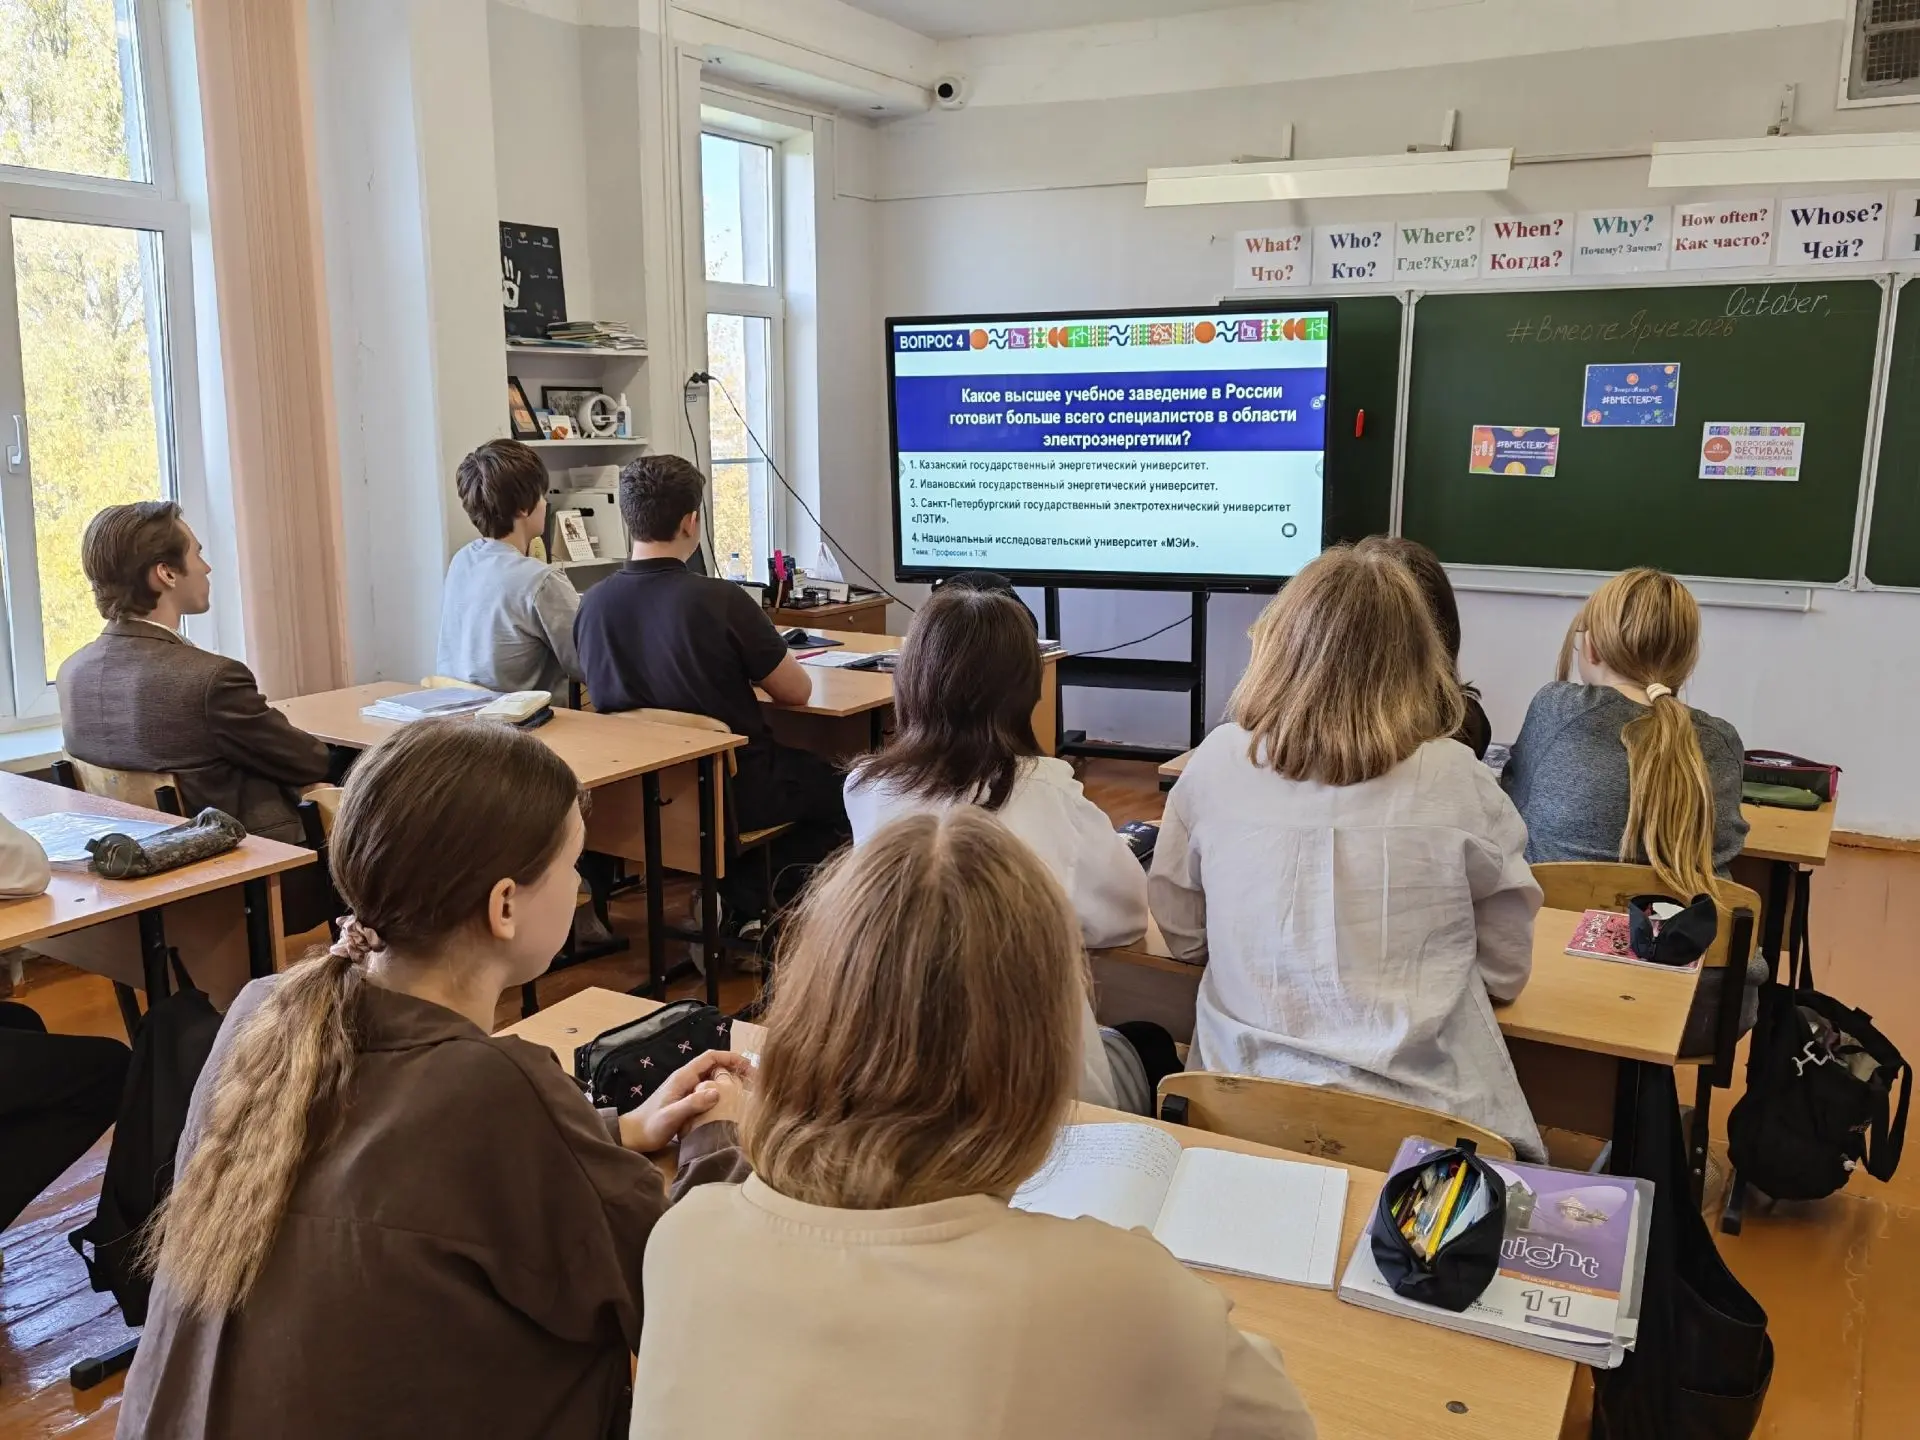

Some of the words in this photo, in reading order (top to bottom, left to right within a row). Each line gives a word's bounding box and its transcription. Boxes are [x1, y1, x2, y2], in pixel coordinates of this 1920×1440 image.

[1681, 213, 1715, 227] How
[1720, 208, 1768, 224] often?
[1790, 203, 1883, 227] Whose?
[1402, 225, 1476, 245] Where?
[1494, 219, 1564, 239] When?
[1593, 214, 1654, 238] Why?
[1246, 235, 1302, 253] What?
[1329, 231, 1382, 249] Who?
[1580, 244, 1623, 256] Почему?
[1626, 242, 1663, 254] Зачем?
[1675, 236, 1708, 251] Как
[1713, 232, 1770, 248] часто?
[1802, 238, 1864, 260] Чей?
[1397, 254, 1478, 272] Где?Куда?
[1490, 251, 1563, 270] Когда?
[1251, 264, 1294, 282] Что?
[1331, 262, 1376, 280] Кто?
[900, 334, 954, 350] ВОПРОС
[955, 333, 964, 348] 4
[961, 388, 1001, 403] Какое
[1004, 390, 1061, 402] высшее
[1064, 385, 1124, 405] учебное
[1128, 387, 1207, 402] заведение
[1211, 387, 1220, 400] в
[1225, 383, 1282, 399] России
[1601, 395, 1663, 405] #ВМЕСТЕЯРЧЕ
[950, 411, 1003, 425] готовит
[1006, 409, 1061, 424] больше
[1064, 411, 1105, 425] всего
[1108, 410, 1214, 426] специалистов
[1218, 410, 1227, 423] в
[1232, 406, 1296, 422] области
[1043, 431, 1191, 448] электроэнергетики?
[1496, 440, 1556, 450] #ВМЕСТЕЯРЧЕ
[1735, 439, 1794, 447] ВСЕРОССИЙСКИЙ
[1734, 446, 1793, 456] ФЕСТИВАЛЬ
[910, 459, 916, 470] 1.
[919, 459, 967, 470] Казанский
[969, 459, 1055, 472] государственный
[1058, 459, 1137, 472] энергетический
[1140, 462, 1208, 472] университет.
[910, 478, 917, 489] 2.
[920, 478, 976, 489] Ивановский
[978, 481, 1064, 491] государственный
[1067, 480, 1146, 492] энергетический
[1149, 482, 1218, 492] университет.
[910, 497, 918, 509] 3.
[920, 497, 1020, 511] Санкт-Петербургский
[1023, 500, 1111, 512] государственный
[1114, 501, 1220, 512] электротехнический
[1222, 503, 1291, 514] университет
[911, 513, 949, 524] «ЛЭТИ».
[911, 532, 919, 543] 4.
[921, 533, 992, 544] Национальный
[995, 536, 1091, 546] исследовательский
[1093, 538, 1157, 549] университет
[1160, 537, 1198, 548] «МЭИ».
[1500, 1236, 1600, 1279] light
[1520, 1289, 1571, 1318] 11
